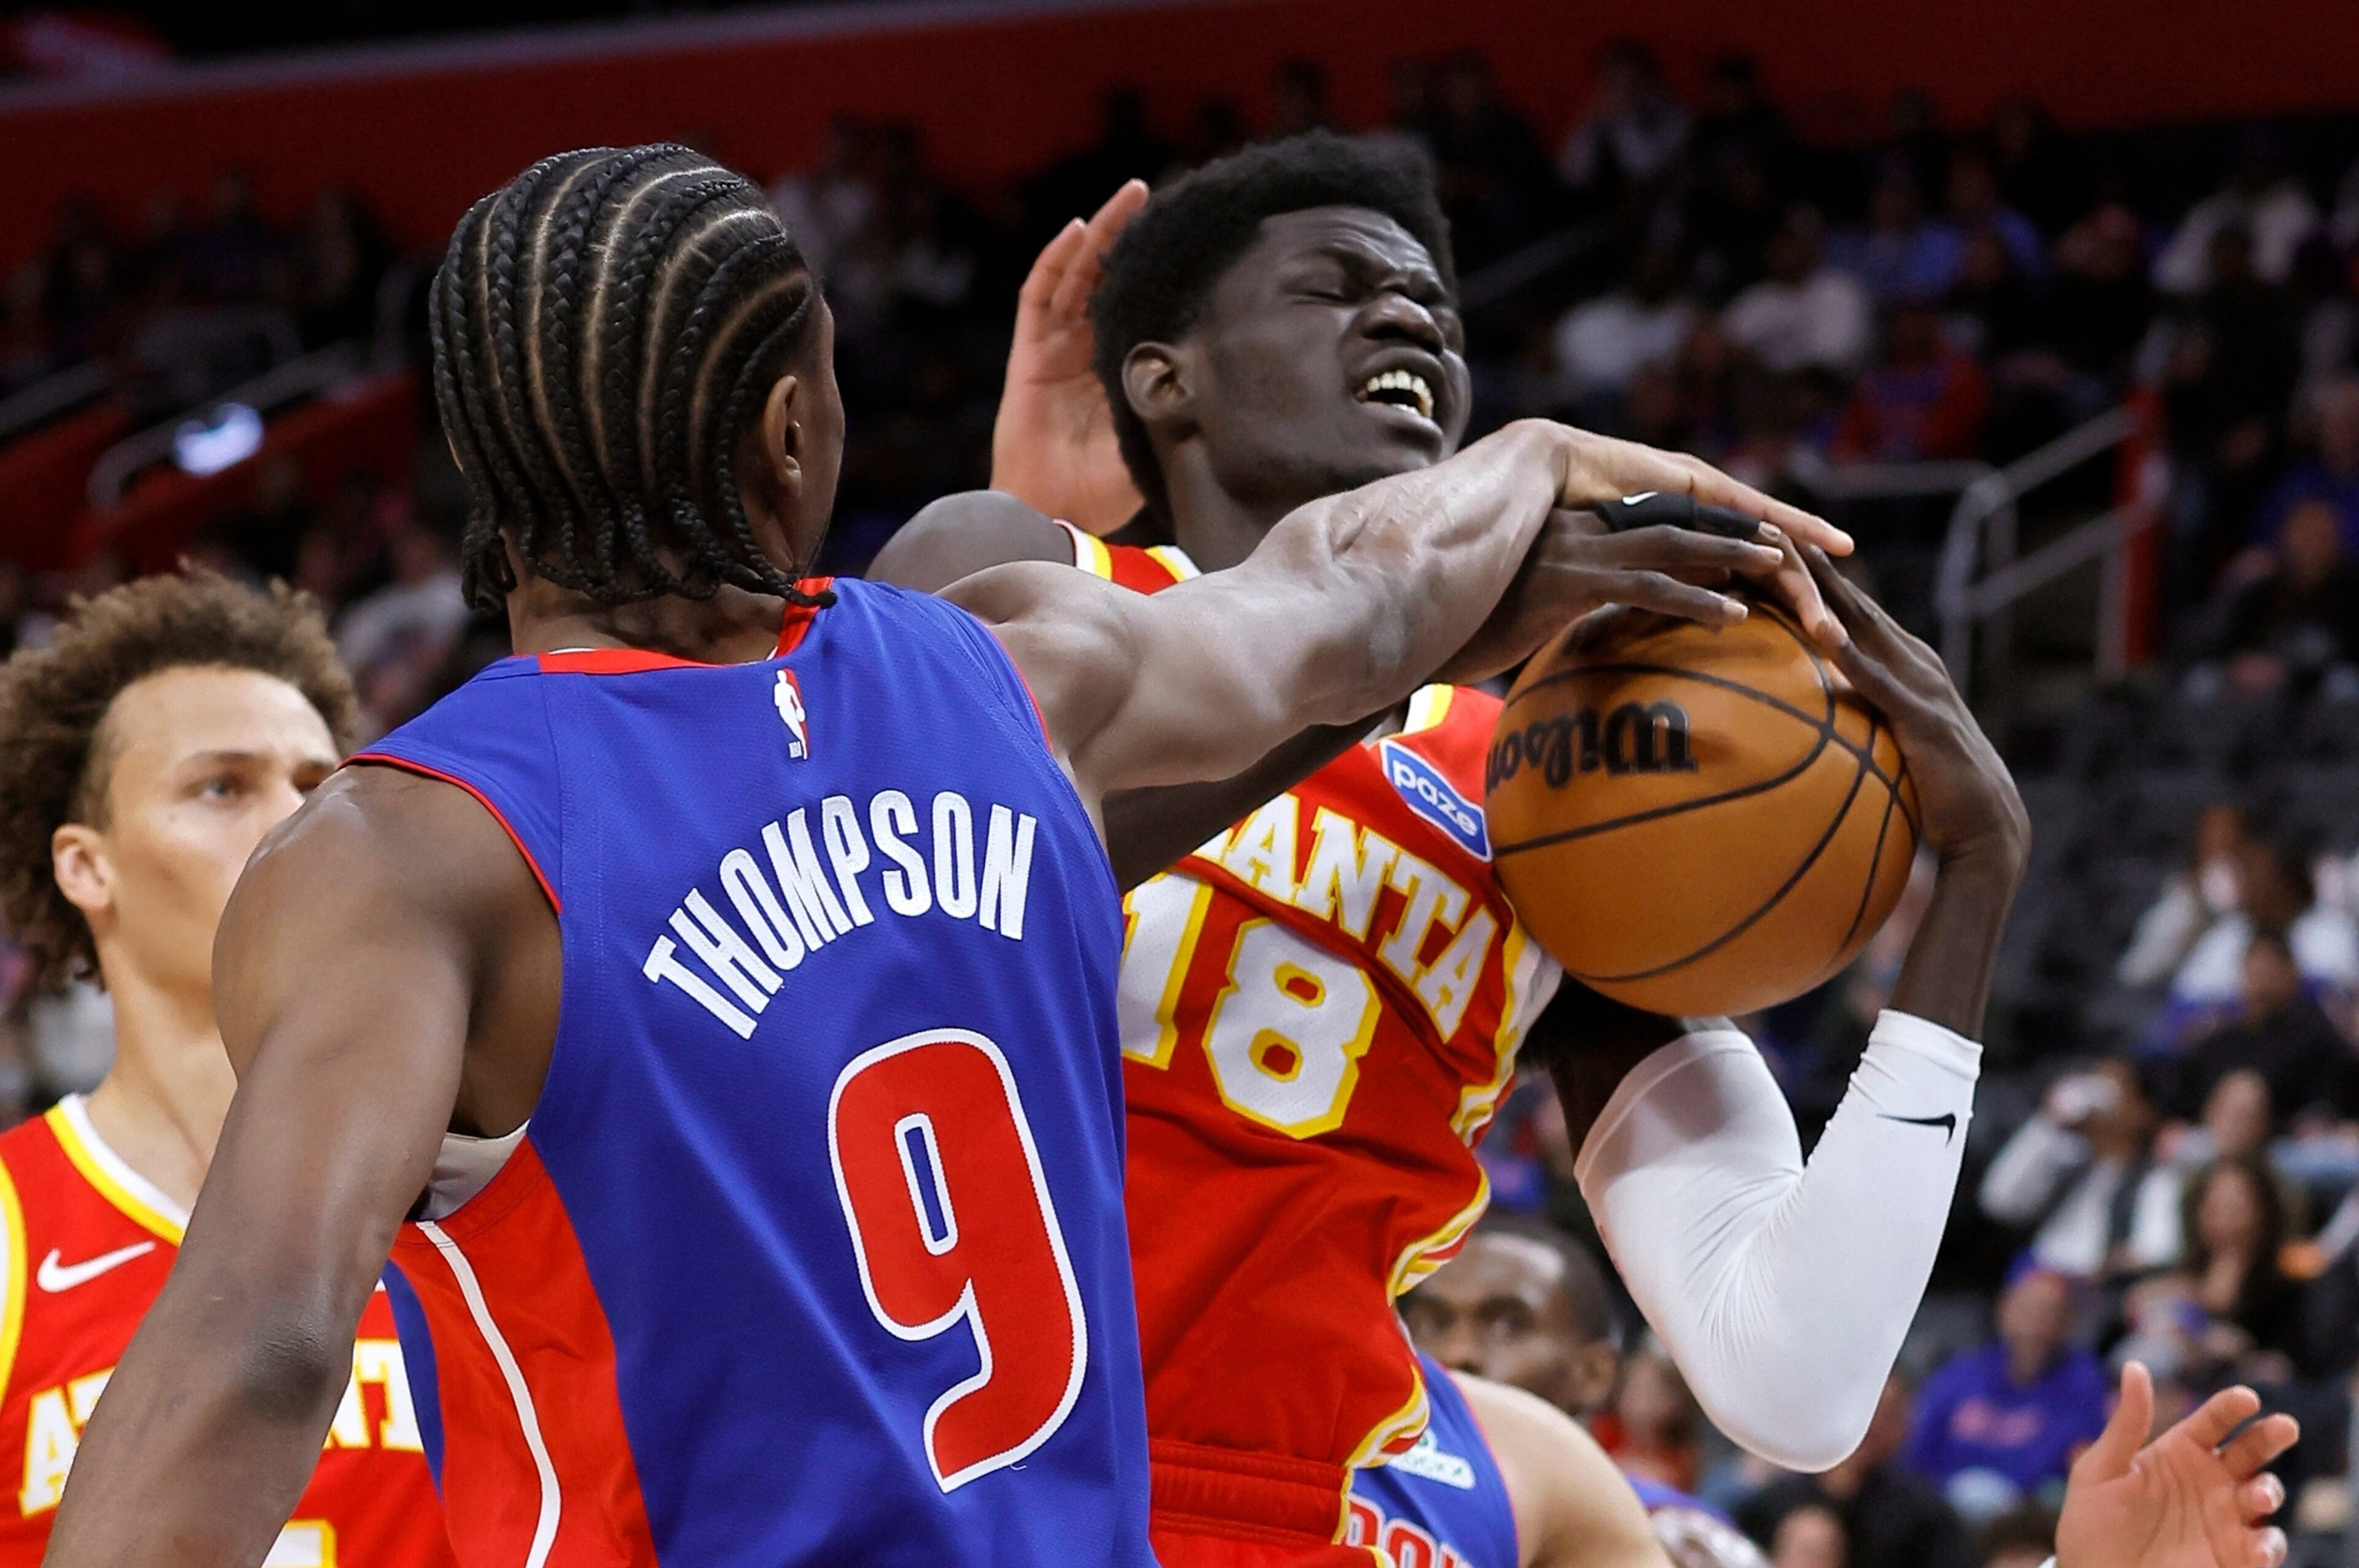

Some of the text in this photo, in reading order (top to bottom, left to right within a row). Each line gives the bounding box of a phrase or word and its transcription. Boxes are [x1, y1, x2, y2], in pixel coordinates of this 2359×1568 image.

[643, 790, 1036, 1040] THOMPSON
[1191, 791, 1499, 1043] ANTA
[1392, 759, 1477, 837] paze
[1119, 870, 1382, 1141] 18
[827, 1027, 1088, 1494] 9
